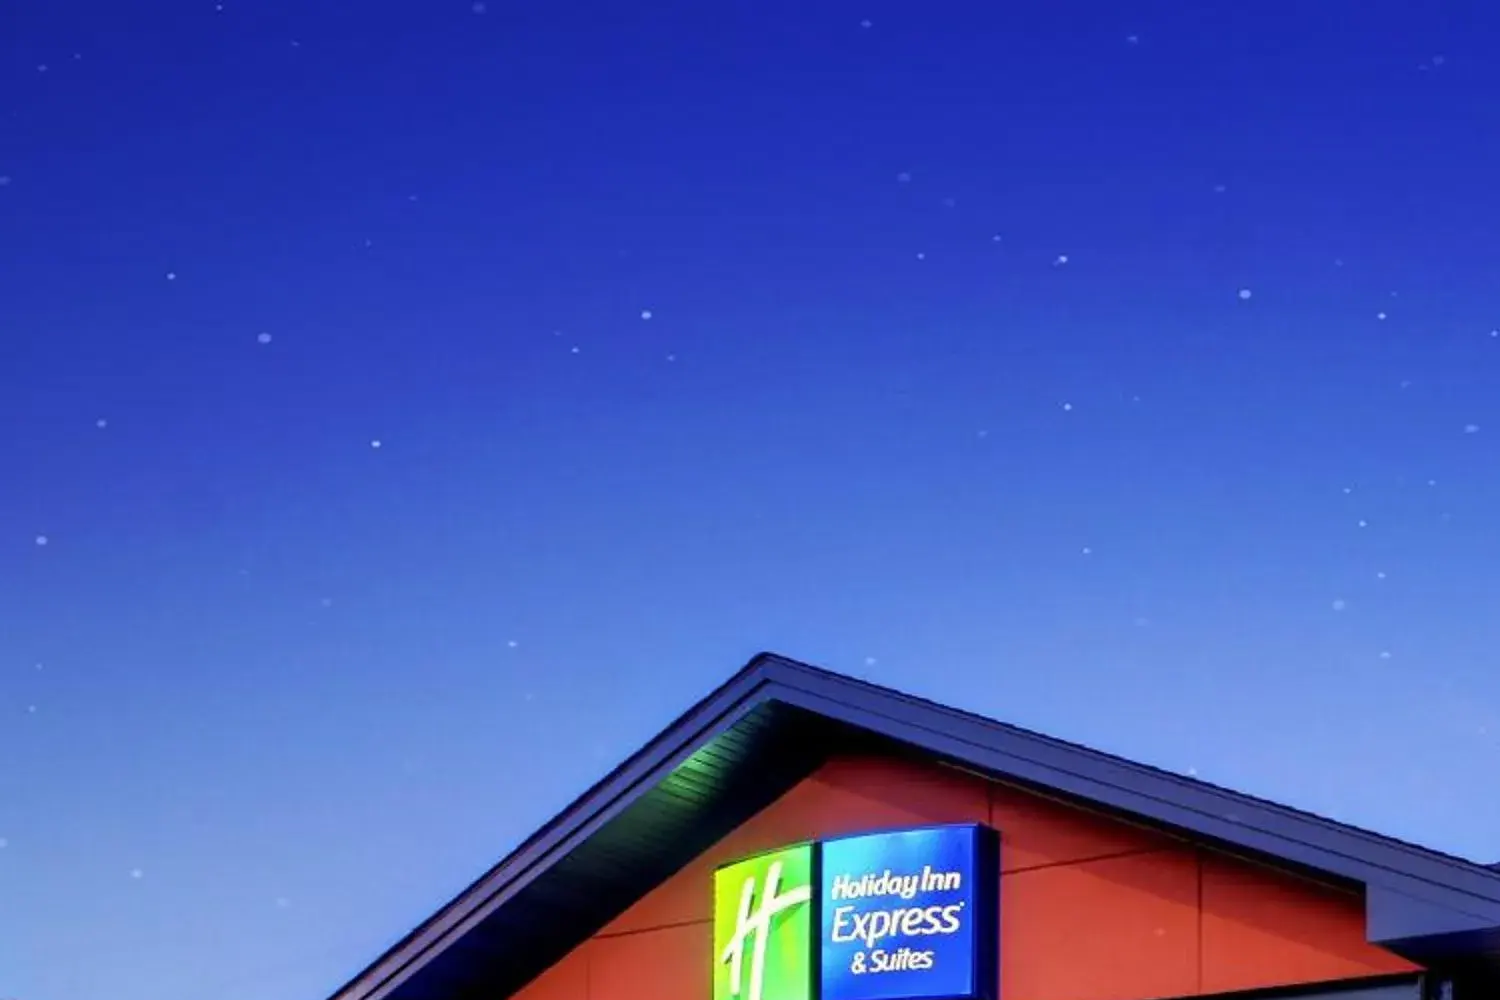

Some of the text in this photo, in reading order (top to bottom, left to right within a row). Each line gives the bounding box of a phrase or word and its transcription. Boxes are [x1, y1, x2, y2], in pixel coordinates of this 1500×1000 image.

[831, 865, 961, 900] Holiday Inn
[831, 903, 962, 948] Express
[850, 947, 935, 975] & Suites
